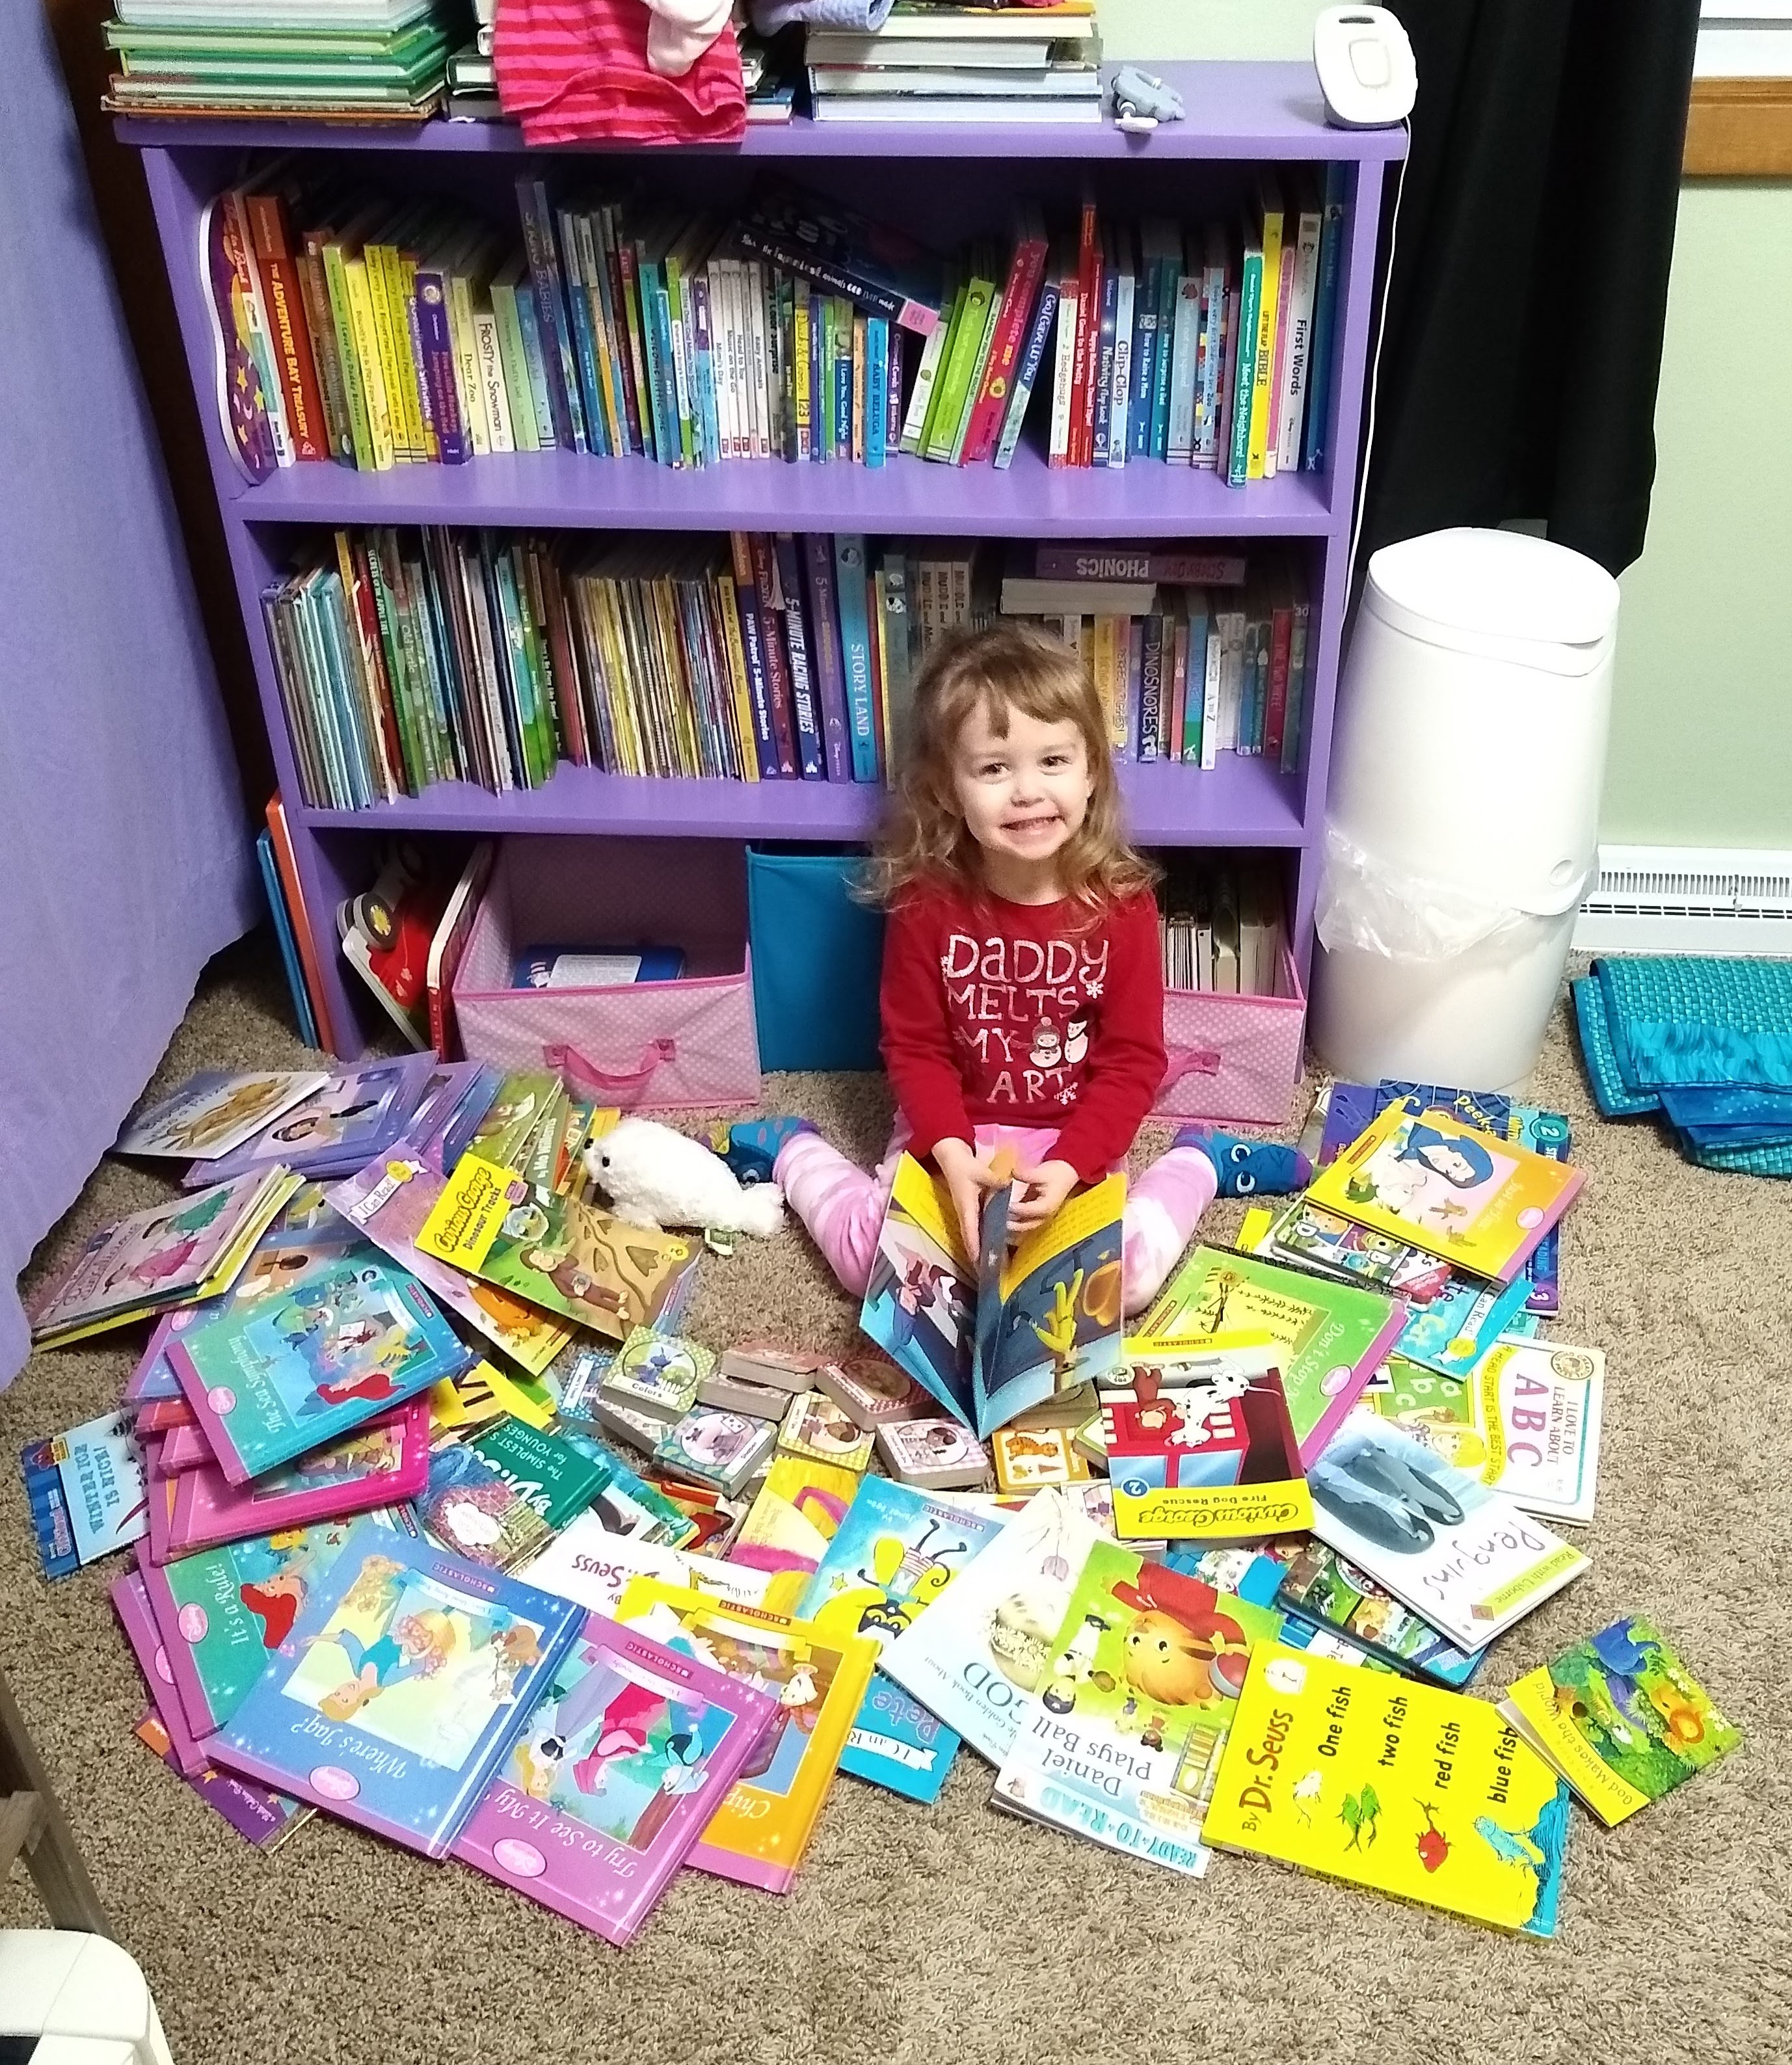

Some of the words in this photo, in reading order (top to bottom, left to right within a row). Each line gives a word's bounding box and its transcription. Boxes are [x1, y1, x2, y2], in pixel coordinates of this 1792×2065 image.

[1024, 251, 1041, 280] you
[271, 279, 295, 355] ADVENTURE
[1006, 279, 1034, 343] complete
[1040, 293, 1056, 315] God
[1079, 292, 1088, 315] Daniel
[479, 322, 496, 363] FROSTY
[796, 313, 809, 347] Duck
[1033, 314, 1050, 343] Gave
[1293, 319, 1307, 349] First
[738, 356, 743, 365] to
[796, 349, 806, 358] &
[1000, 344, 1015, 367] me
[1028, 342, 1043, 360] Us
[286, 356, 301, 384] BAY
[463, 353, 475, 380] Dear
[487, 364, 495, 377] the
[796, 360, 809, 393] Goose
[1021, 359, 1037, 382] You
[1057, 354, 1069, 405] Hedgehugs
[1073, 362, 1083, 384] Potty
[1112, 340, 1129, 405] Clip-Clop
[1239, 362, 1251, 386] Meet
[1289, 354, 1305, 396] Words
[467, 382, 478, 403] Zoo
[487, 379, 507, 431] Snowman
[1238, 388, 1249, 405] the
[291, 385, 310, 439] TREASURY
[1232, 406, 1250, 457] Neighbors!
[399, 624, 413, 645] Old
[745, 613, 755, 633] PAW
[784, 596, 805, 651] 5-MINUTE
[762, 615, 780, 670] 5-Minute
[404, 645, 419, 673] Turtle
[792, 652, 809, 690] RACING
[848, 643, 868, 691] STORY
[753, 667, 764, 708] 5-Minute
[769, 671, 782, 710] Stories
[1140, 641, 1160, 734] DINOSNORES
[758, 709, 770, 740] Stories
[796, 691, 814, 734] STORIES
[852, 697, 872, 737] LAND
[946, 983, 1079, 1021] MELTS
[954, 1027, 1019, 1063] MY
[1542, 1126, 1559, 1136] 2
[373, 1176, 396, 1201] Read!
[358, 1206, 369, 1214] I
[362, 1194, 382, 1214] Can
[433, 1203, 472, 1255] Curious
[453, 1166, 498, 1211] George
[462, 1213, 488, 1251] Dinosaur
[481, 1186, 502, 1214] Tracks
[1531, 1291, 1549, 1301] 3
[1311, 1322, 1344, 1359] Don't
[227, 1335, 265, 1392] Symphony
[1289, 1355, 1321, 1385] Stop
[1486, 1351, 1503, 1373] HEAD
[250, 1387, 276, 1412] Sea
[632, 1383, 663, 1398] Colors
[1484, 1376, 1495, 1404] START
[1550, 1385, 1566, 1422] LEARN
[260, 1408, 286, 1435] The
[1487, 1416, 1497, 1432] THE
[1564, 1407, 1578, 1436] LOVE
[72, 1443, 90, 1469] ICE
[498, 1435, 547, 1471] SIMPLEST
[1490, 1434, 1501, 1456] BEST
[1545, 1426, 1562, 1464] ABOUT
[1562, 1439, 1575, 1455] TO
[92, 1445, 115, 1488] NICE!
[544, 1462, 564, 1480] The
[1482, 1458, 1501, 1487] START
[78, 1469, 106, 1533] WINTER
[102, 1489, 120, 1506] IS
[524, 1488, 553, 1517] By
[1130, 1482, 1141, 1494] 2
[922, 1504, 977, 1527] SCHOLASTIC
[1139, 1507, 1216, 1527] George
[1213, 1504, 1298, 1523] Curious
[1531, 1562, 1551, 1583] with
[1550, 1551, 1572, 1568] Read
[200, 1560, 239, 1607] Rule!
[433, 1562, 488, 1591] SCHOLASTIC
[1493, 1577, 1530, 1604] Usborne
[223, 1603, 239, 1616] a
[721, 1600, 778, 1623] SCHOLASTIC
[221, 1616, 250, 1647] It's
[626, 1640, 682, 1675] SCHOLASTIC
[922, 1655, 950, 1683] About
[950, 1677, 974, 1703] Book
[1327, 1686, 1351, 1720] fish
[1533, 1680, 1561, 1722] World
[868, 1688, 940, 1746] Pete
[974, 1698, 1007, 1728] Golden
[1384, 1696, 1408, 1729] fish
[289, 1713, 338, 1747] Jaq?
[1032, 1715, 1081, 1753] Ball
[1246, 1709, 1294, 1772] Seuss
[1318, 1724, 1343, 1757] One
[1437, 1722, 1460, 1755] fish
[335, 1735, 407, 1780] Where's
[1087, 1739, 1153, 1780] Plays
[1378, 1734, 1400, 1766] two
[1572, 1742, 1609, 1785] Makes
[1041, 1747, 1123, 1796] Daniel
[1436, 1761, 1452, 1789] red
[1487, 1766, 1512, 1804] blue
[491, 1785, 531, 1822] My
[720, 1787, 771, 1820] Chip
[1238, 1775, 1273, 1813] Dr.
[1607, 1781, 1633, 1805] God
[526, 1809, 548, 1832] It
[547, 1819, 585, 1852] See
[1242, 1812, 1262, 1832] By
[580, 1836, 604, 1860] to
[600, 1843, 641, 1880] Try
